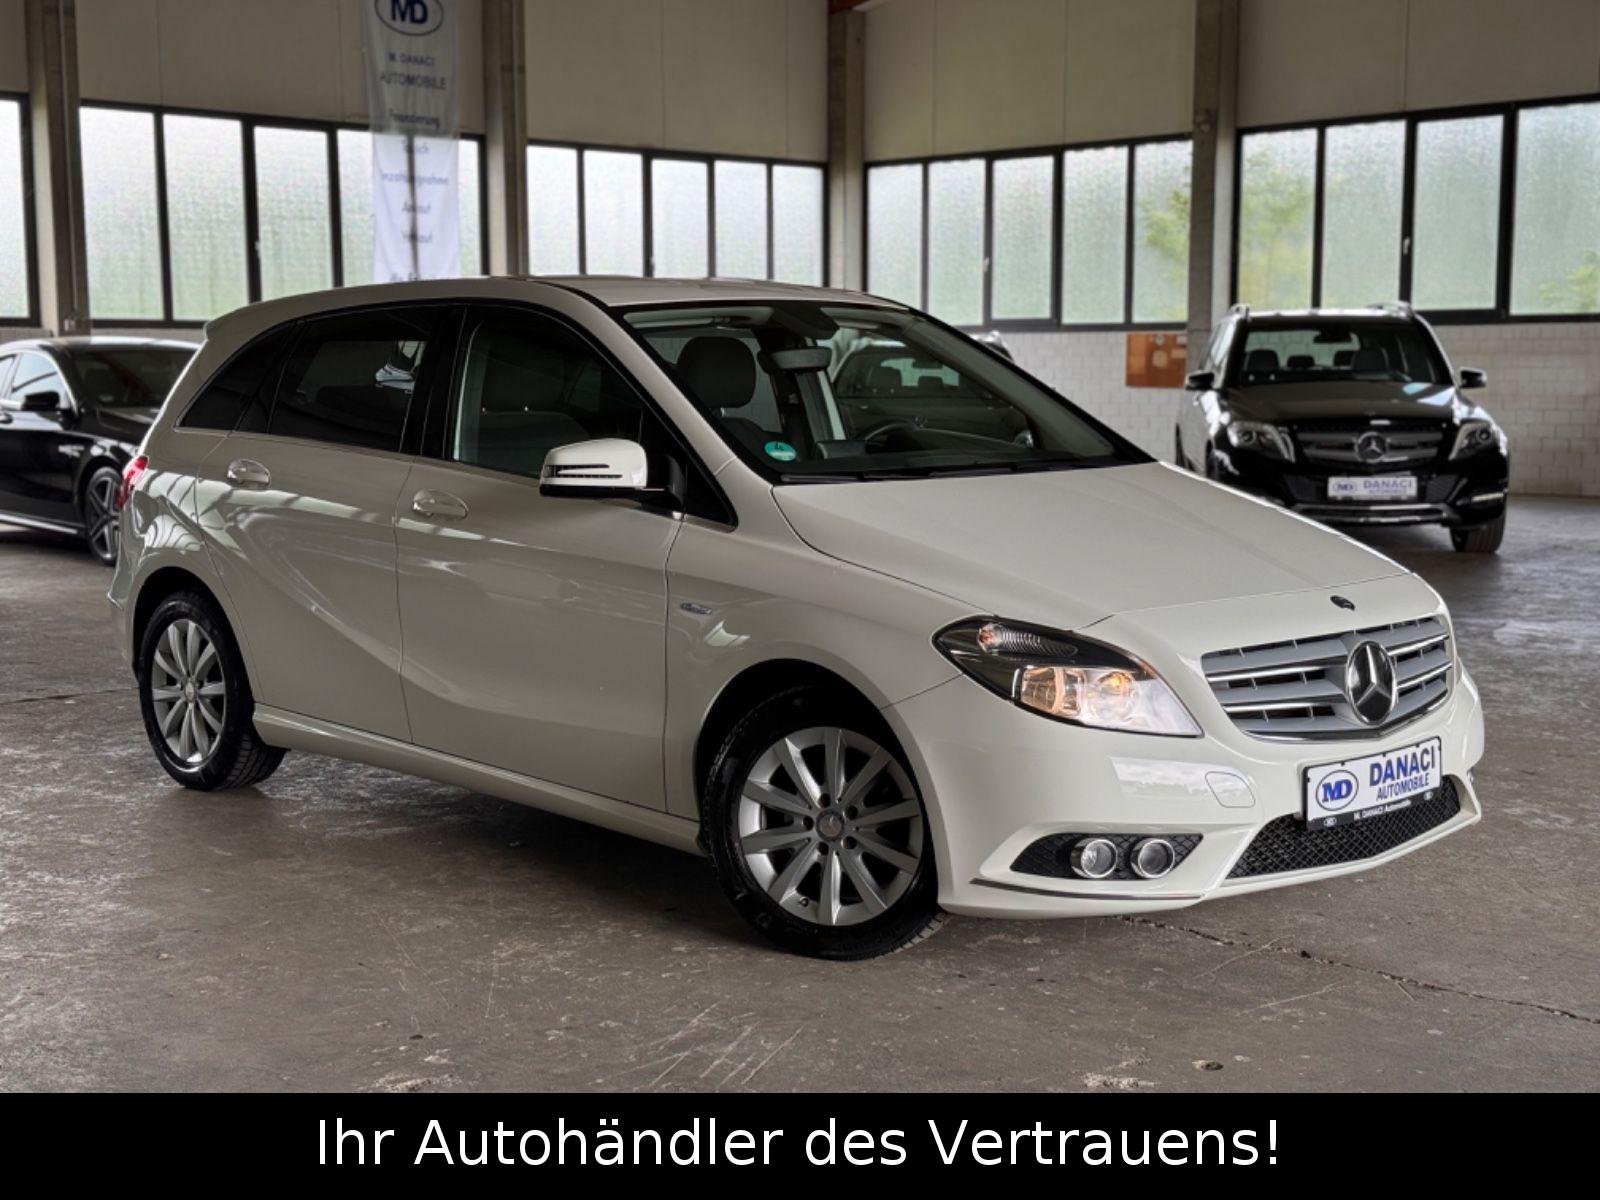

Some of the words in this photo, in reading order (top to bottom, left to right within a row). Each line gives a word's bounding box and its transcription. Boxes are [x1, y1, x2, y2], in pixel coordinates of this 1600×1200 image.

[380, 71, 447, 90] AUTOMOBILE
[1363, 480, 1412, 489] DANACI
[1369, 745, 1435, 787] DANACI
[1321, 779, 1353, 803] MD
[1376, 773, 1430, 801] AUTOMOBILE
